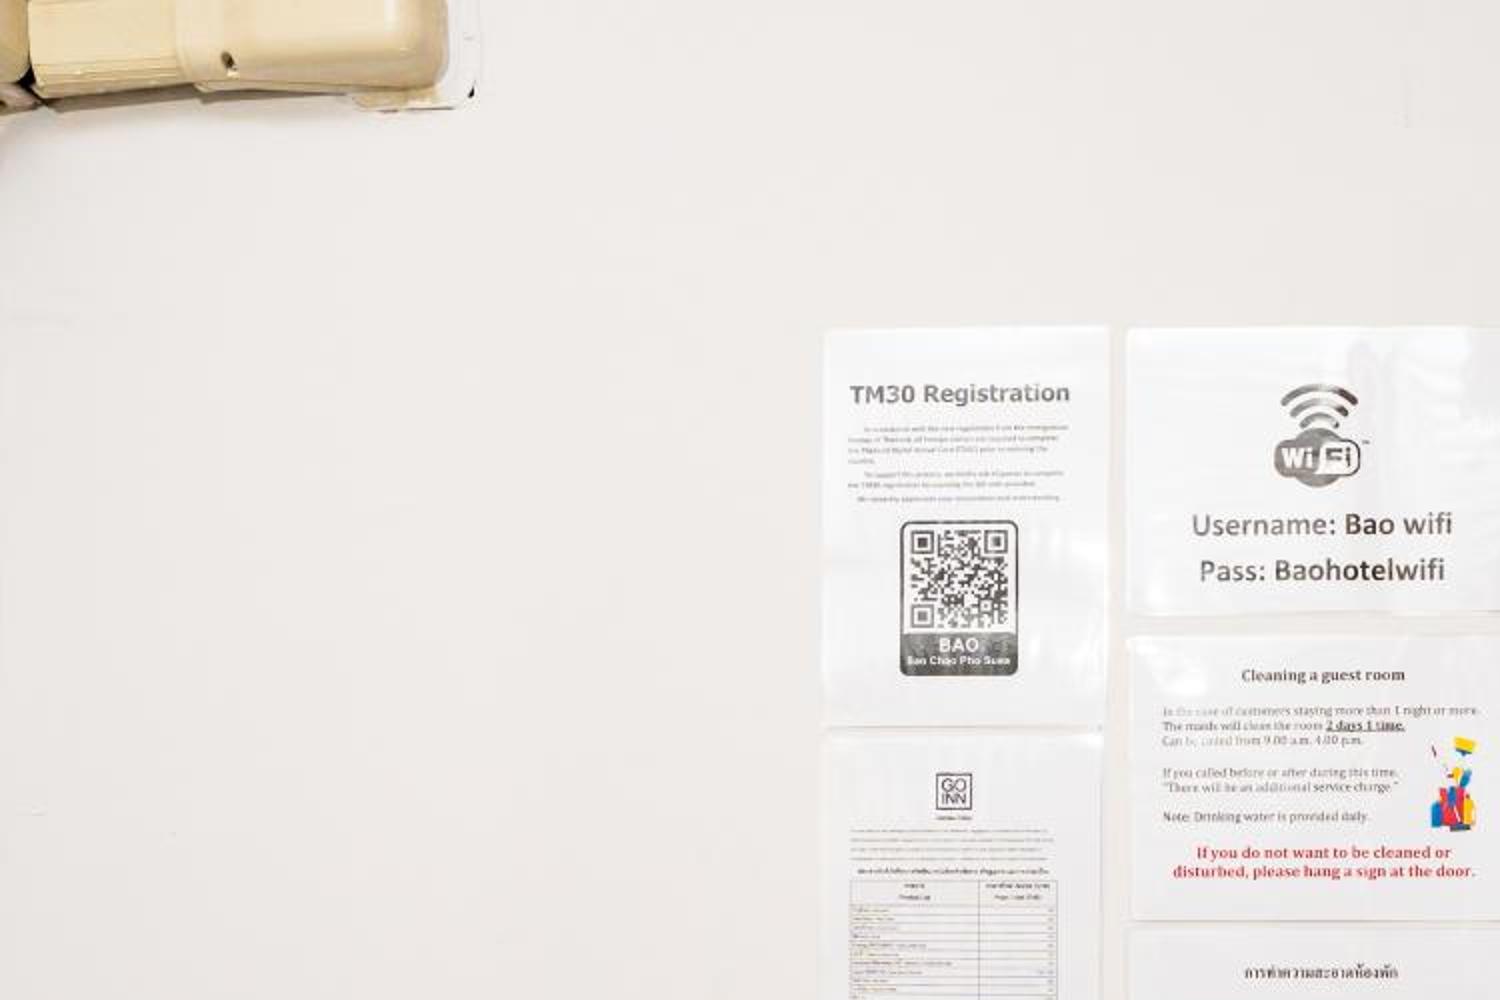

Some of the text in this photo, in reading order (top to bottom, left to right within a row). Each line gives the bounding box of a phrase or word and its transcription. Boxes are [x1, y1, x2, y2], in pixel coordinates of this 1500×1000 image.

[850, 384, 1069, 407] TM30 Registration
[1193, 512, 1452, 536] Username: Bao wifi
[1201, 558, 1444, 582] Pass: Baohotelwifi
[939, 637, 979, 652] BAO
[1242, 669, 1405, 684] Cleaning a guest room
[1294, 707, 1332, 718] staying
[1334, 707, 1364, 716] more
[1366, 705, 1390, 715] than
[1403, 705, 1431, 718] night
[1162, 721, 1182, 731] The
[1220, 720, 1241, 731] will
[1274, 720, 1290, 731] the
[1336, 720, 1363, 733] days
[1161, 736, 1182, 747] Can
[1163, 768, 1172, 778] If
[1173, 770, 1192, 780] you
[1229, 768, 1264, 778] before
[1267, 769, 1279, 778] or
[1282, 768, 1307, 777] after
[1310, 768, 1347, 780] during
[942, 778, 966, 792] GO
[1313, 783, 1352, 792] service
[942, 793, 966, 804] INN
[1194, 811, 1241, 824] Drinking
[1243, 813, 1275, 822] water
[1197, 846, 1451, 861] If you do not want to be cleaned or
[1173, 864, 1476, 880] disturbed, please hang a sign at the door.
